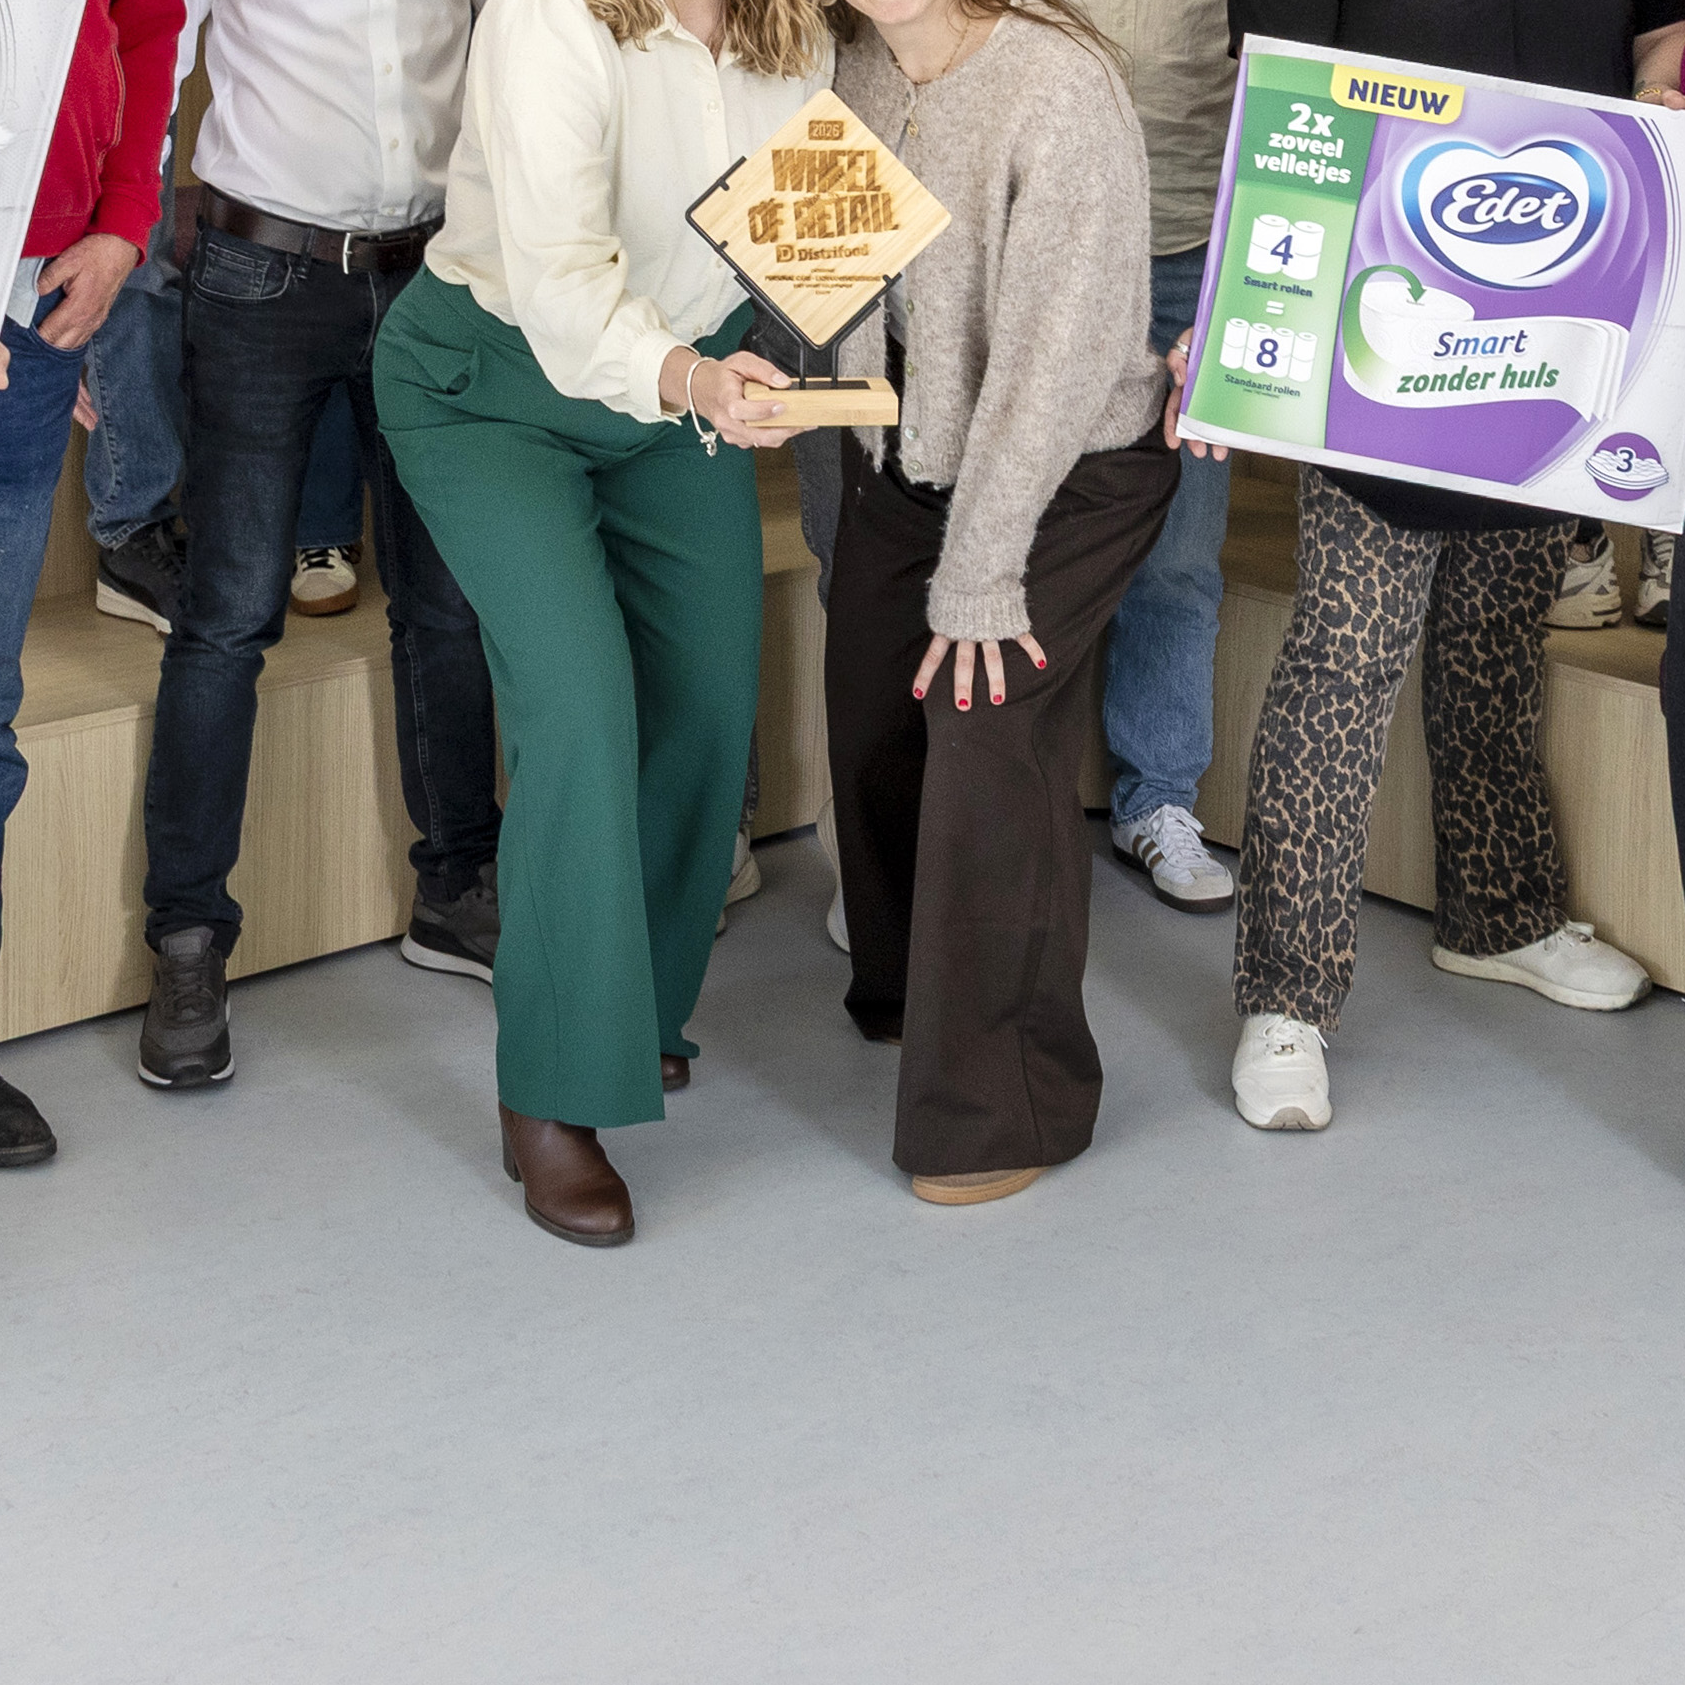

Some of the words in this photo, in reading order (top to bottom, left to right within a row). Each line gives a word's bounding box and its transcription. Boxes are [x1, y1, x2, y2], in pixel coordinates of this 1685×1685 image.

[1347, 78, 1450, 116] NIEUW
[811, 123, 840, 138] 2026
[1287, 102, 1335, 137] 2x
[1268, 132, 1344, 159] zoveel
[771, 148, 882, 193] WHEEL
[1254, 153, 1352, 185] velletjes
[748, 198, 785, 245] OF
[793, 192, 900, 240] RETAIL
[1442, 178, 1572, 234] Edet
[798, 244, 870, 262] Distrifood
[1270, 234, 1294, 266] 4
[1243, 275, 1278, 291] Smart
[1280, 284, 1313, 298] rollen
[1256, 338, 1279, 368] 8
[1433, 329, 1528, 358] Smart
[1224, 373, 1272, 392] Standaard
[1273, 381, 1301, 397] rollen
[1396, 365, 1496, 394] zonder
[1499, 362, 1560, 390] huls
[1615, 449, 1634, 473] 3
